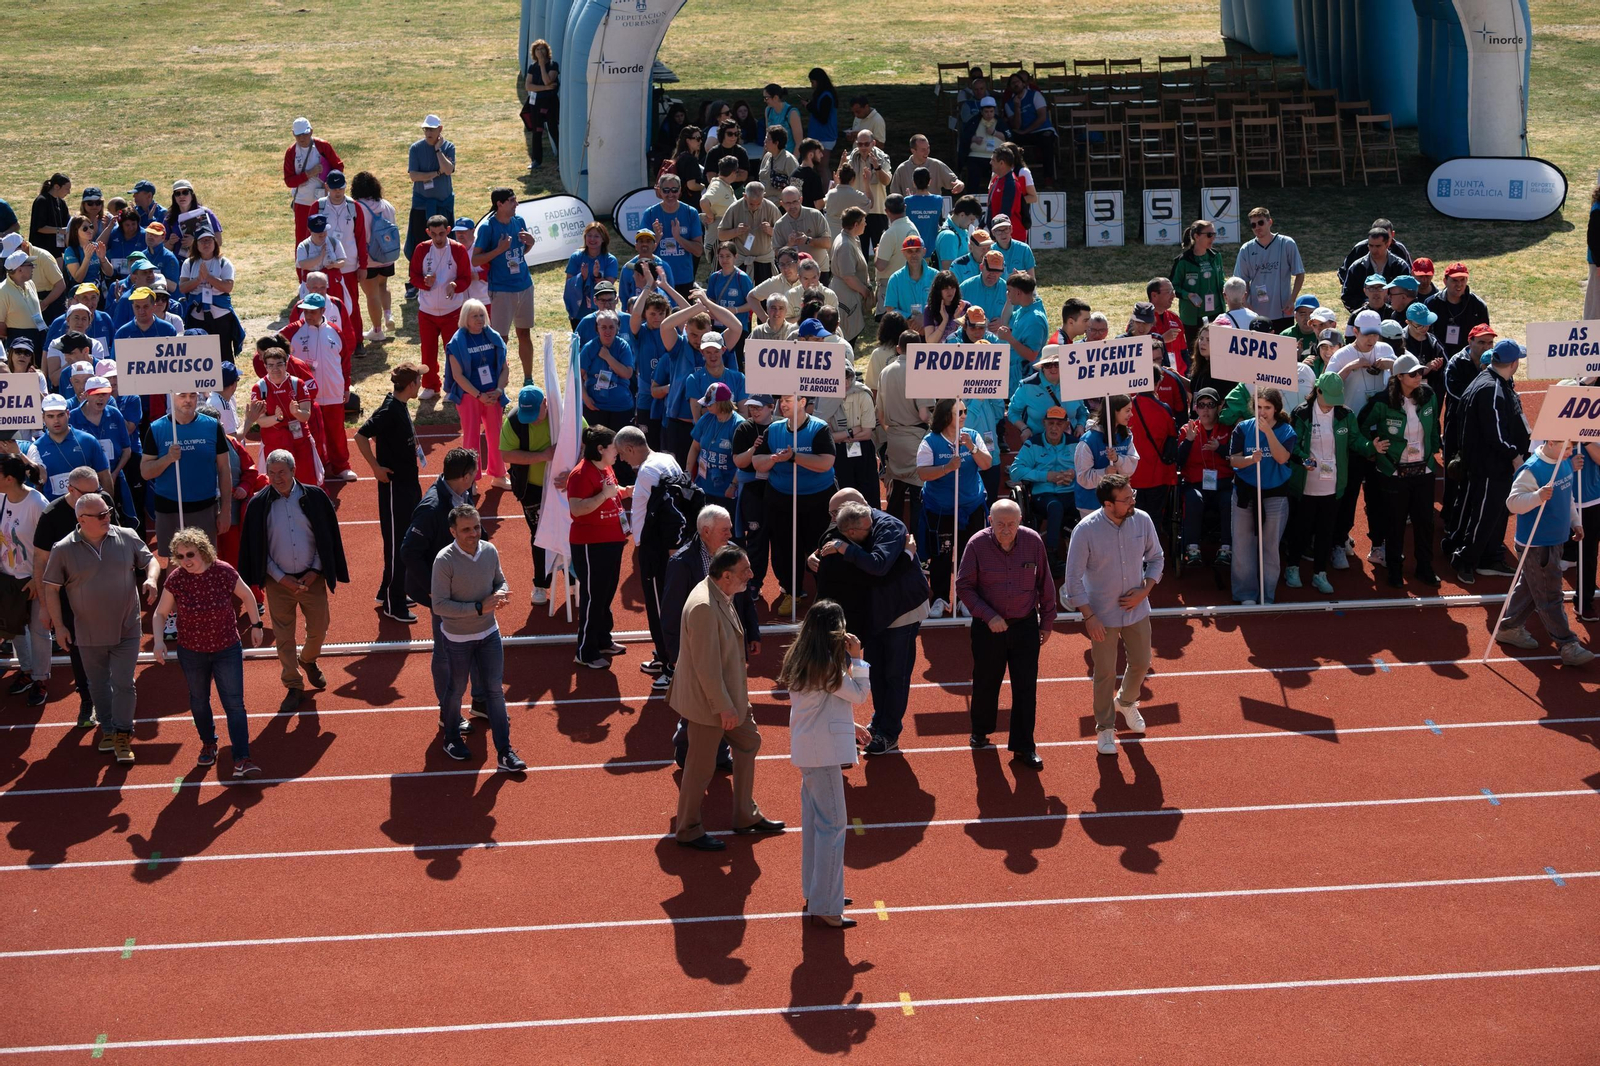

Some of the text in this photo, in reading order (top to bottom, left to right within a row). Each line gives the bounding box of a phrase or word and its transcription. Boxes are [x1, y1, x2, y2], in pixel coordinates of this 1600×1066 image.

[622, 19, 660, 27] OURENSE
[1489, 36, 1523, 45] inorde
[608, 64, 644, 74] inorde
[1454, 180, 1485, 188] XUNTA
[1453, 189, 1503, 197] DE GALICIA
[544, 206, 583, 220] FADEMGA
[1043, 200, 1051, 222] 1
[1094, 199, 1115, 222] 3
[1152, 198, 1173, 220] 5
[1210, 196, 1231, 218] 7
[560, 220, 586, 231] Plena
[1568, 327, 1588, 341] AS
[155, 343, 187, 357] SAN
[1068, 343, 1143, 365] S. VICENTE
[1228, 335, 1278, 361] ASPAS
[758, 348, 832, 370] CON ELES
[913, 351, 1002, 370] PRODEME
[127, 358, 213, 375] FRANCISCO
[1078, 360, 1135, 380] DE PAUL
[195, 379, 216, 388] VIGO
[799, 377, 839, 385] VILAGARCIA
[1128, 378, 1148, 388] LUGO
[1256, 373, 1292, 385] SANTIAGO
[809, 385, 837, 393] AROUSA
